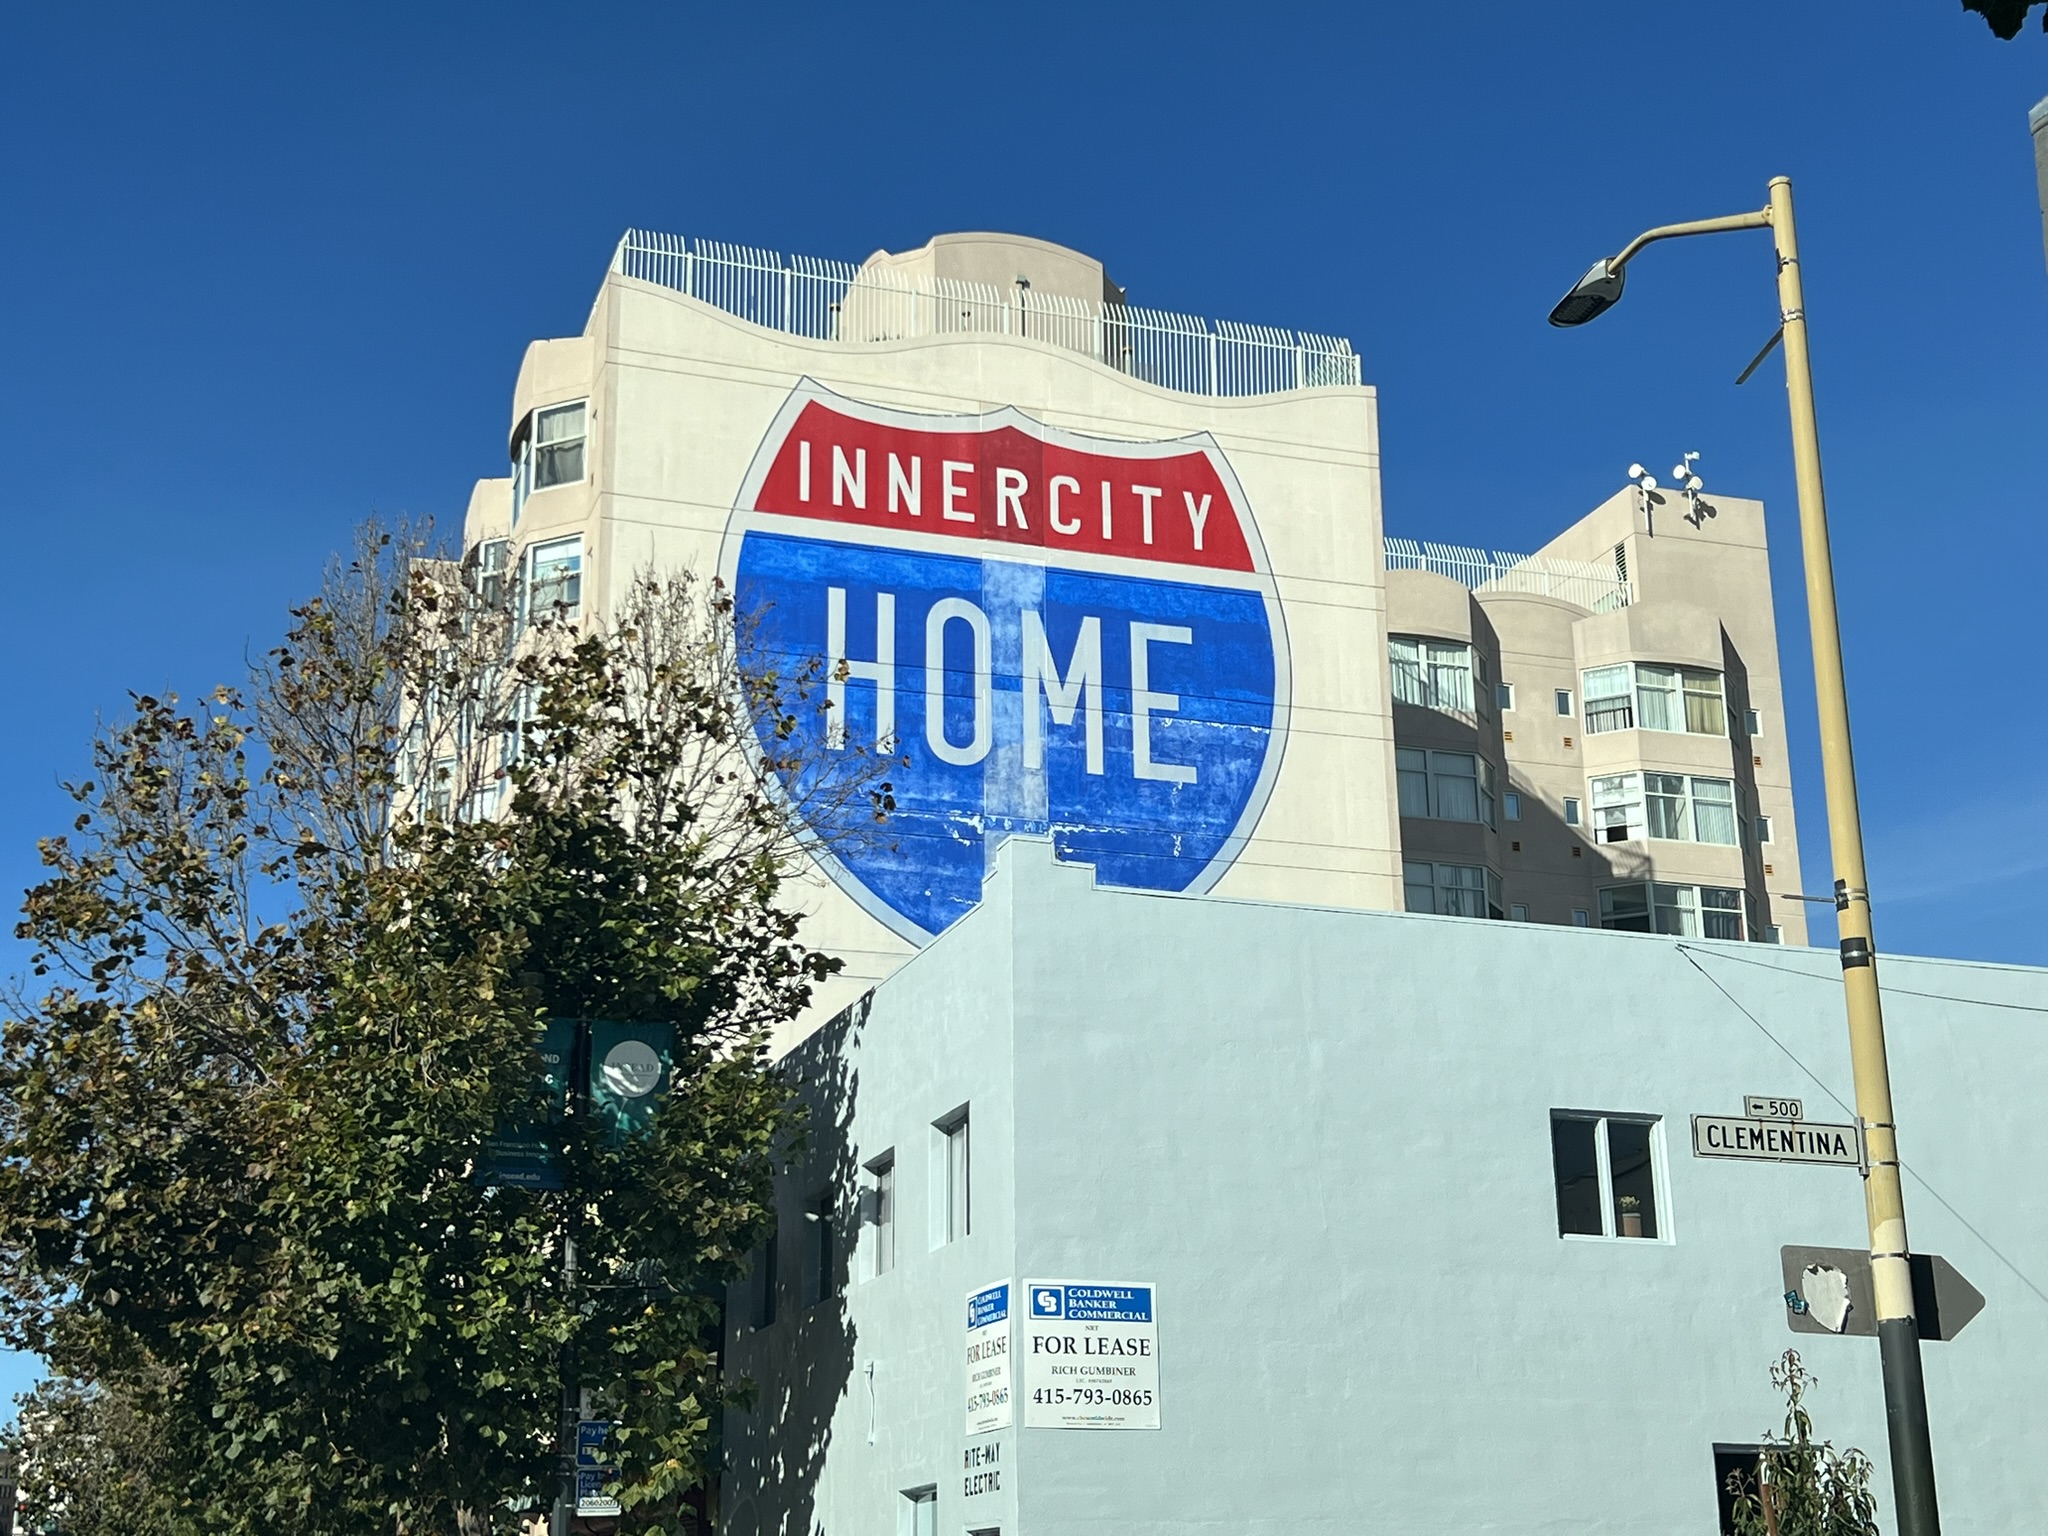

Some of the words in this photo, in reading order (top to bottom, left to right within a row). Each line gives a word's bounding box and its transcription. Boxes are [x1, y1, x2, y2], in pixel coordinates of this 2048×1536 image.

[798, 440, 1212, 552] INNERCITY
[826, 586, 1198, 784] HOME
[1769, 1100, 1798, 1117] 500
[1707, 1124, 1848, 1157] CLEMENTINA
[1068, 1288, 1134, 1300] COLDWELL
[1068, 1299, 1117, 1309] BANKER
[1068, 1309, 1149, 1321] COMMERCIAL
[967, 1344, 980, 1365] FOR
[981, 1336, 1007, 1360] LEASE
[1032, 1336, 1077, 1355] FOR
[1083, 1337, 1151, 1357] LEASE
[1051, 1366, 1078, 1376] RICH
[1079, 1366, 1136, 1377] GUMBINER
[1033, 1387, 1153, 1406] 415-793-0865
[580, 1425, 597, 1437] Pay
[963, 1441, 1001, 1469] RITE-WAY
[963, 1470, 1001, 1497] ELECTRIC
